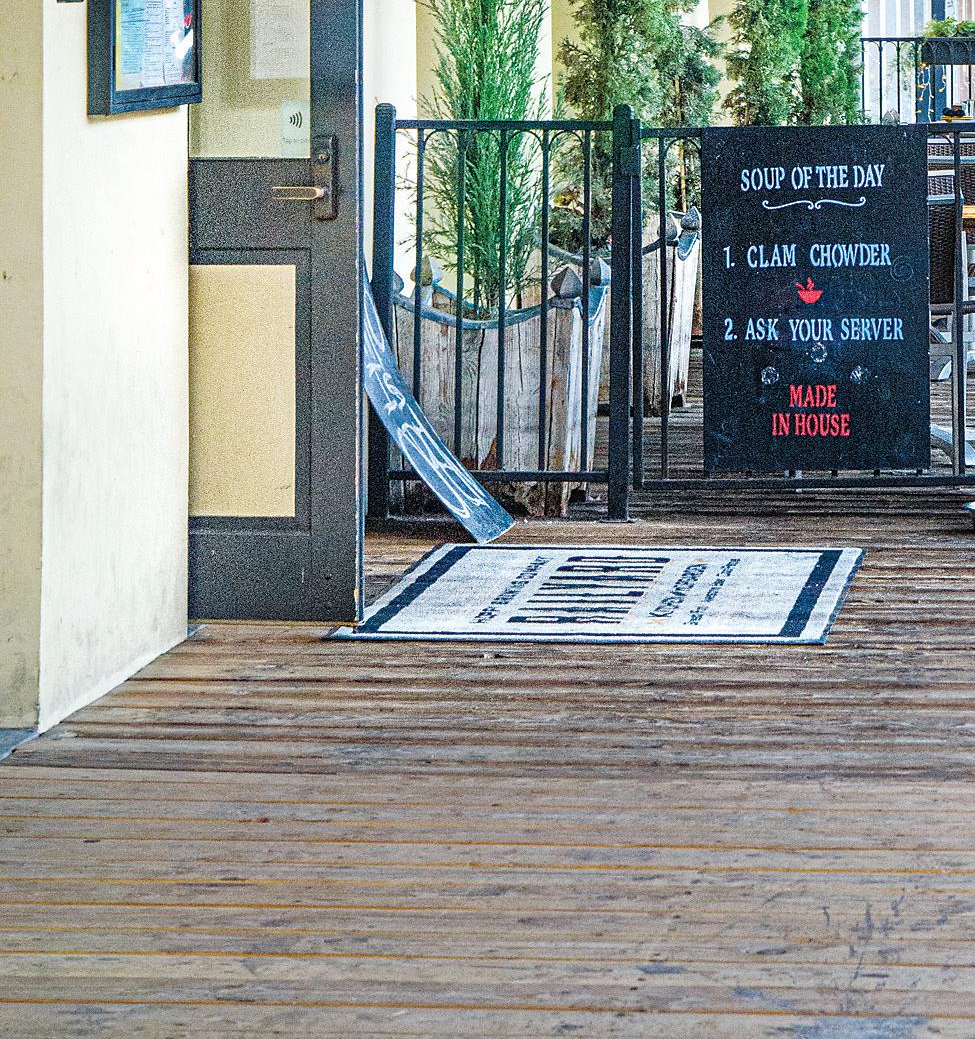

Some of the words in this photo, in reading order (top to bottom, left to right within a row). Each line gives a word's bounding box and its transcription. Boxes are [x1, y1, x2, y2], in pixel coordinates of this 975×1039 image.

[740, 166, 786, 192] SOUP
[791, 166, 813, 191] OF
[816, 165, 849, 189] THE
[853, 163, 886, 188] DAY
[724, 245, 736, 268] 1.
[747, 243, 797, 268] CLAM
[809, 242, 892, 268] CHOWDER
[724, 318, 738, 341] 2.
[745, 318, 779, 341] ASK
[789, 319, 834, 342] YOUR
[840, 318, 905, 341] SERVER
[789, 384, 838, 408] MADE
[771, 413, 791, 436] IN
[794, 413, 851, 437] HOUSE
